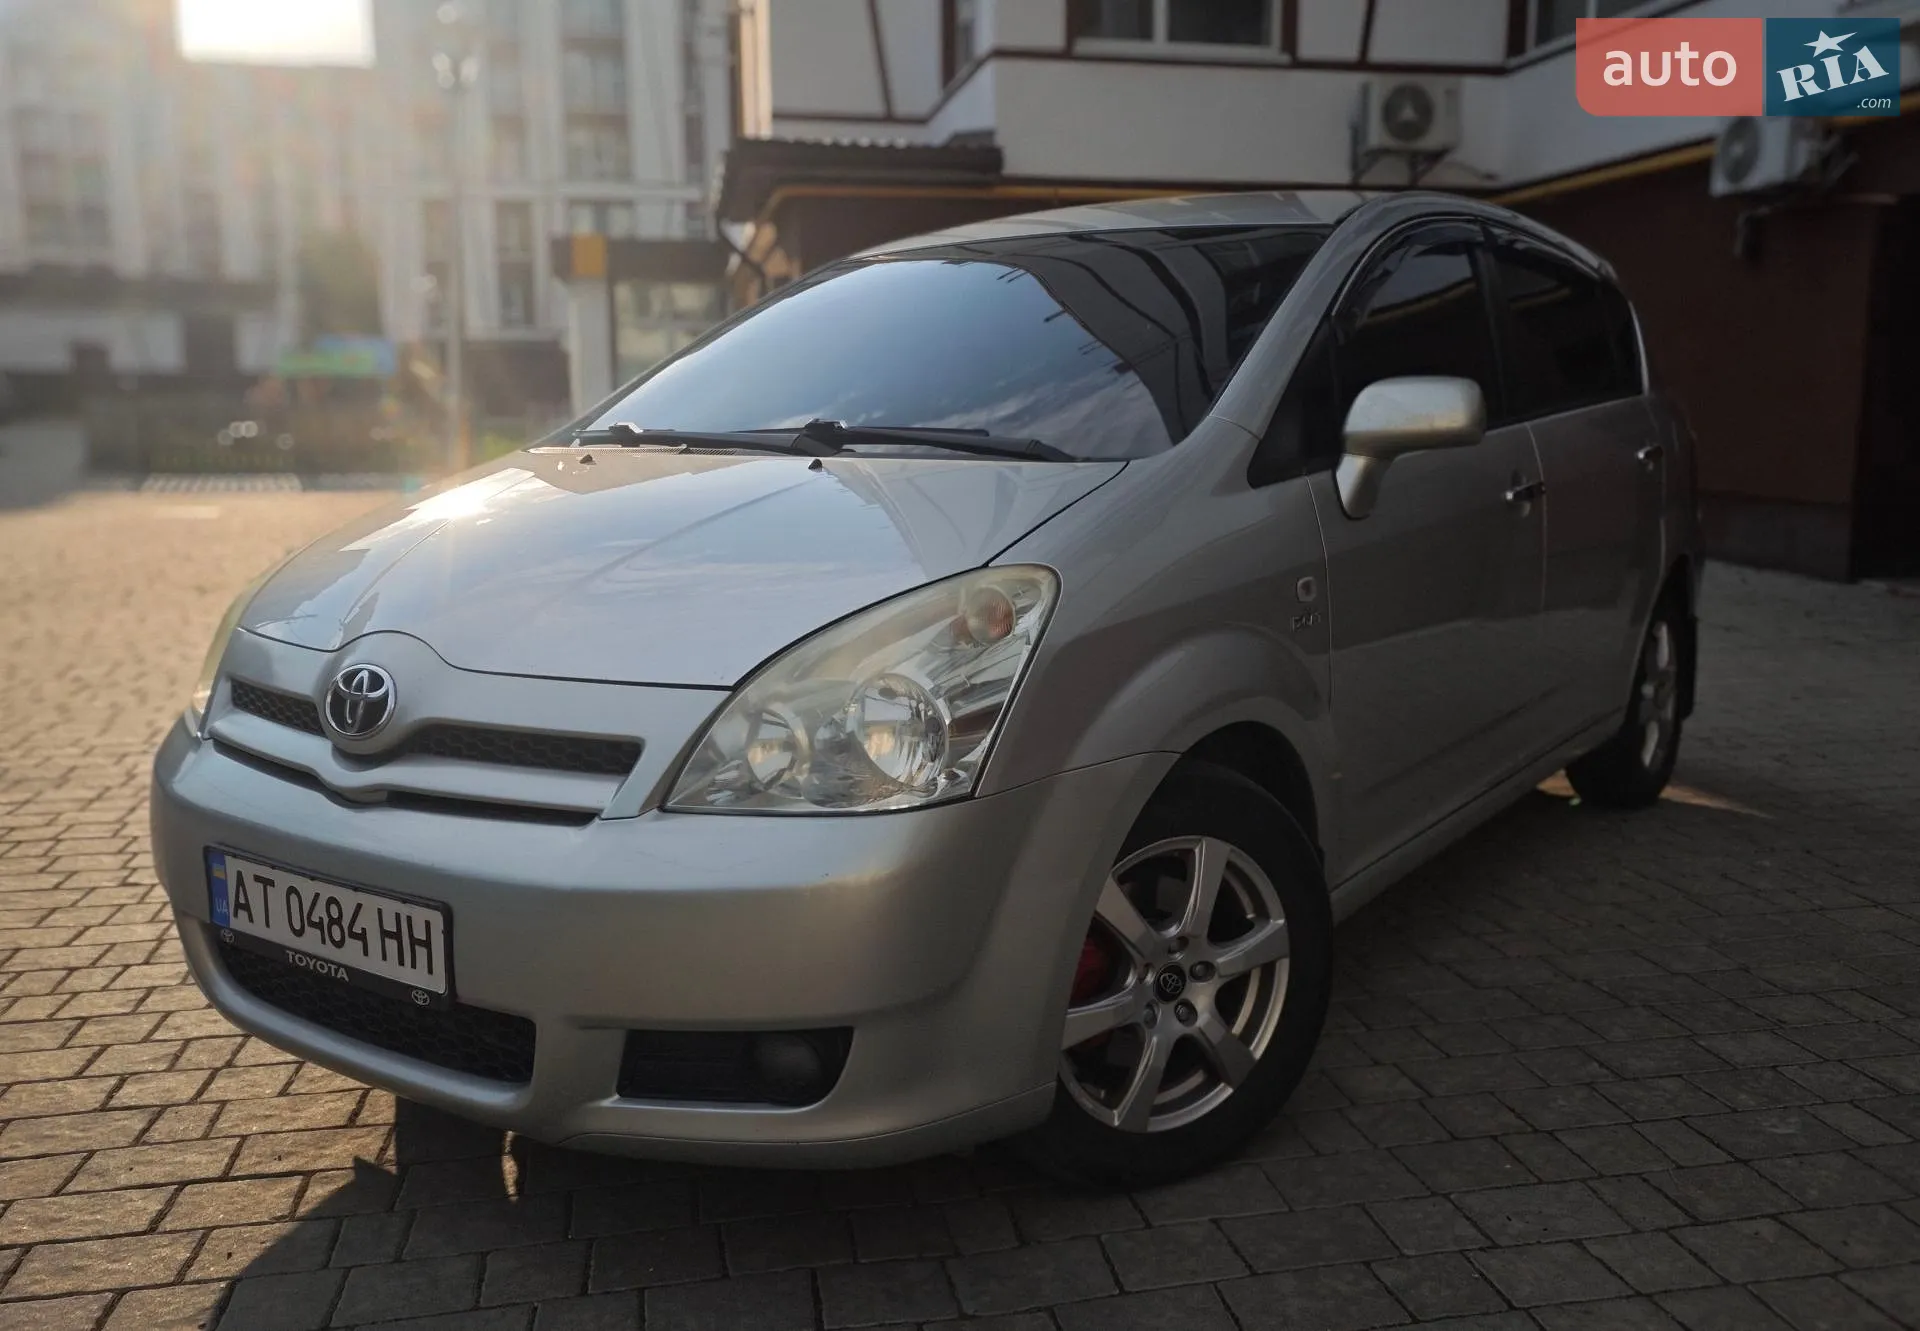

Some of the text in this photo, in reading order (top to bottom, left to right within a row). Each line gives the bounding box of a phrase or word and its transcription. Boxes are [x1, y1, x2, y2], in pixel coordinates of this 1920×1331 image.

[214, 896, 229, 916] UA
[232, 869, 434, 976] AT 0484 HH
[285, 950, 350, 983] TOYOTA
